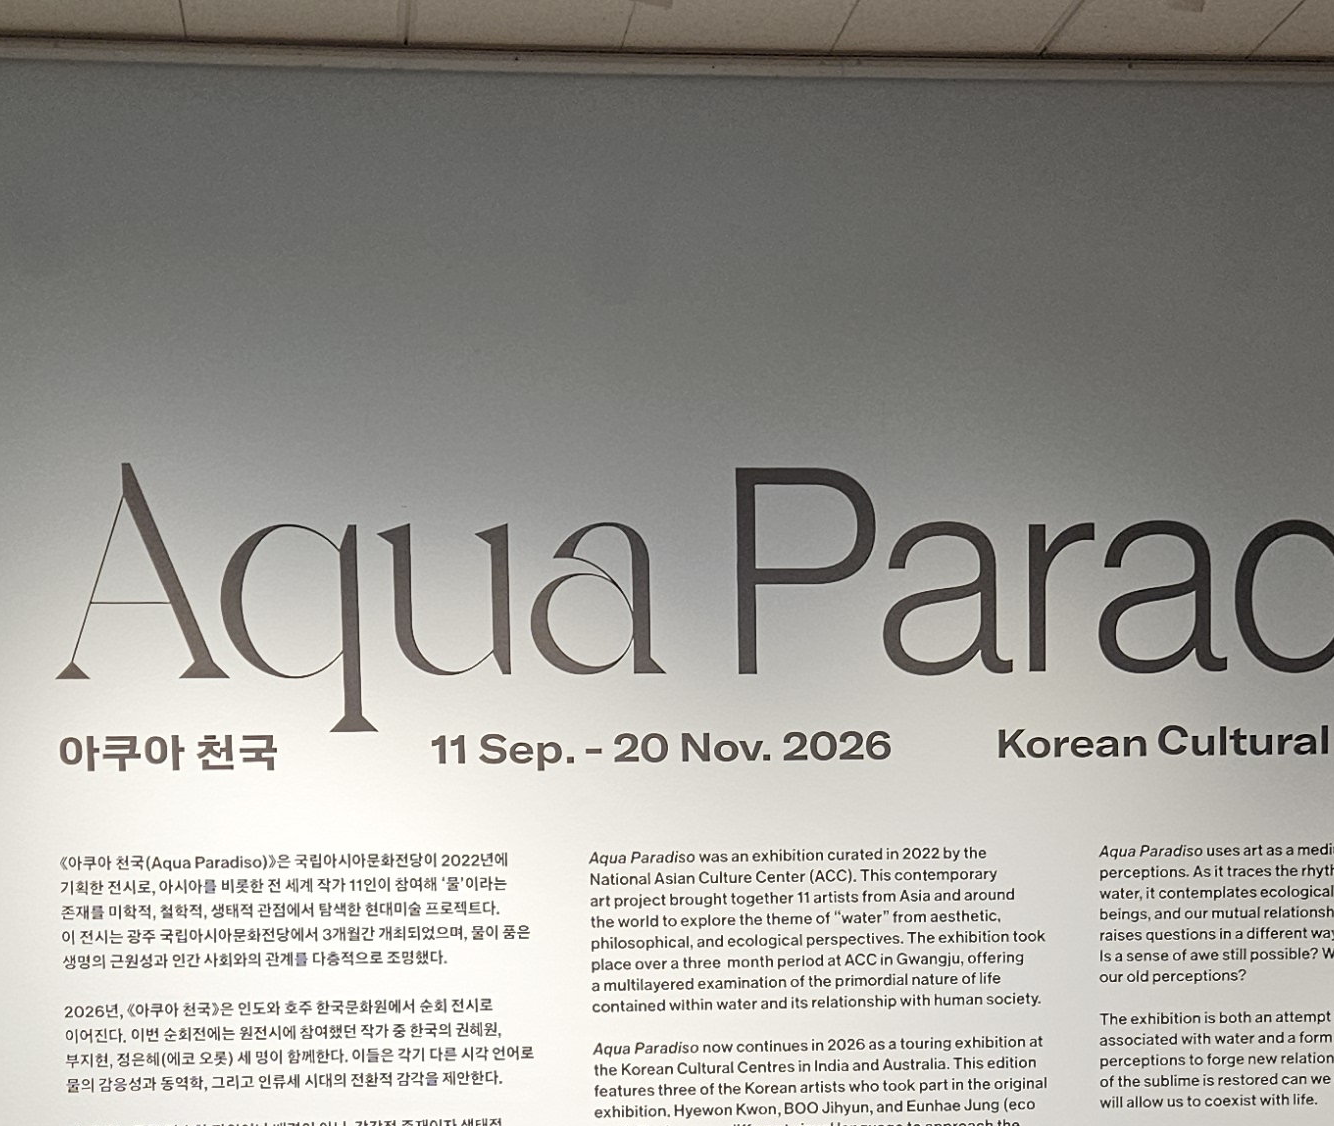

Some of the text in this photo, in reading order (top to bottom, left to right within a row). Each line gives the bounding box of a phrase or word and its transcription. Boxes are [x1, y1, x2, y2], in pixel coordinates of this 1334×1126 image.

[54, 462, 668, 733] Aqua
[432, 735, 465, 764] 11
[479, 734, 574, 771] Sep.
[614, 733, 668, 763] 20
[682, 733, 770, 762] Nov.
[783, 731, 891, 761] 2026
[998, 729, 1147, 758] Korean
[1158, 725, 1328, 756] Cultural
[59, 735, 278, 771] 아쿠아 천국
[60, 852, 507, 871] 《아쿠아 천국(Aqua Paradiso)》은 국립아시아문화전당이 2022년에
[589, 847, 987, 866] Aqua Paradiso was an exhibition curated in 2022 by the
[590, 869, 997, 885] National Asian Culture Center (ACC). This contemporary
[1099, 888, 1142, 901] water,
[1145, 887, 1156, 899] it
[1159, 886, 1257, 901] contemplates
[1260, 885, 1334, 900] ecological
[61, 901, 499, 920] 존재를 미학적, 철학적, 생태적 관점에서 탐색한 현대미술 프로젝트다.
[592, 930, 1045, 952] philosophical, and ecological perspectives. The exhibition took
[63, 950, 447, 969] 생명의 근원성과 인간 사회와의 관계를 다층적으로 조명했다.
[1098, 969, 1246, 985] our old perceptions?
[64, 998, 493, 1020] 2026년, 《아쿠아 천국》은 인도와 호주 한국문화원에서 순회 전시로
[1100, 1013, 1127, 1025] The
[1131, 1012, 1201, 1024] exhibition
[1203, 1011, 1217, 1024] is
[1219, 1011, 1252, 1023] both
[1254, 1014, 1273, 1023] an
[1276, 1011, 1331, 1025] attempt
[594, 1097, 1035, 1119] exhibition. Hyewon Kwon, BOO Jihyun, and Eunhae Jung (eco
[1099, 1093, 1318, 1108] will allow us to coexist with life.
